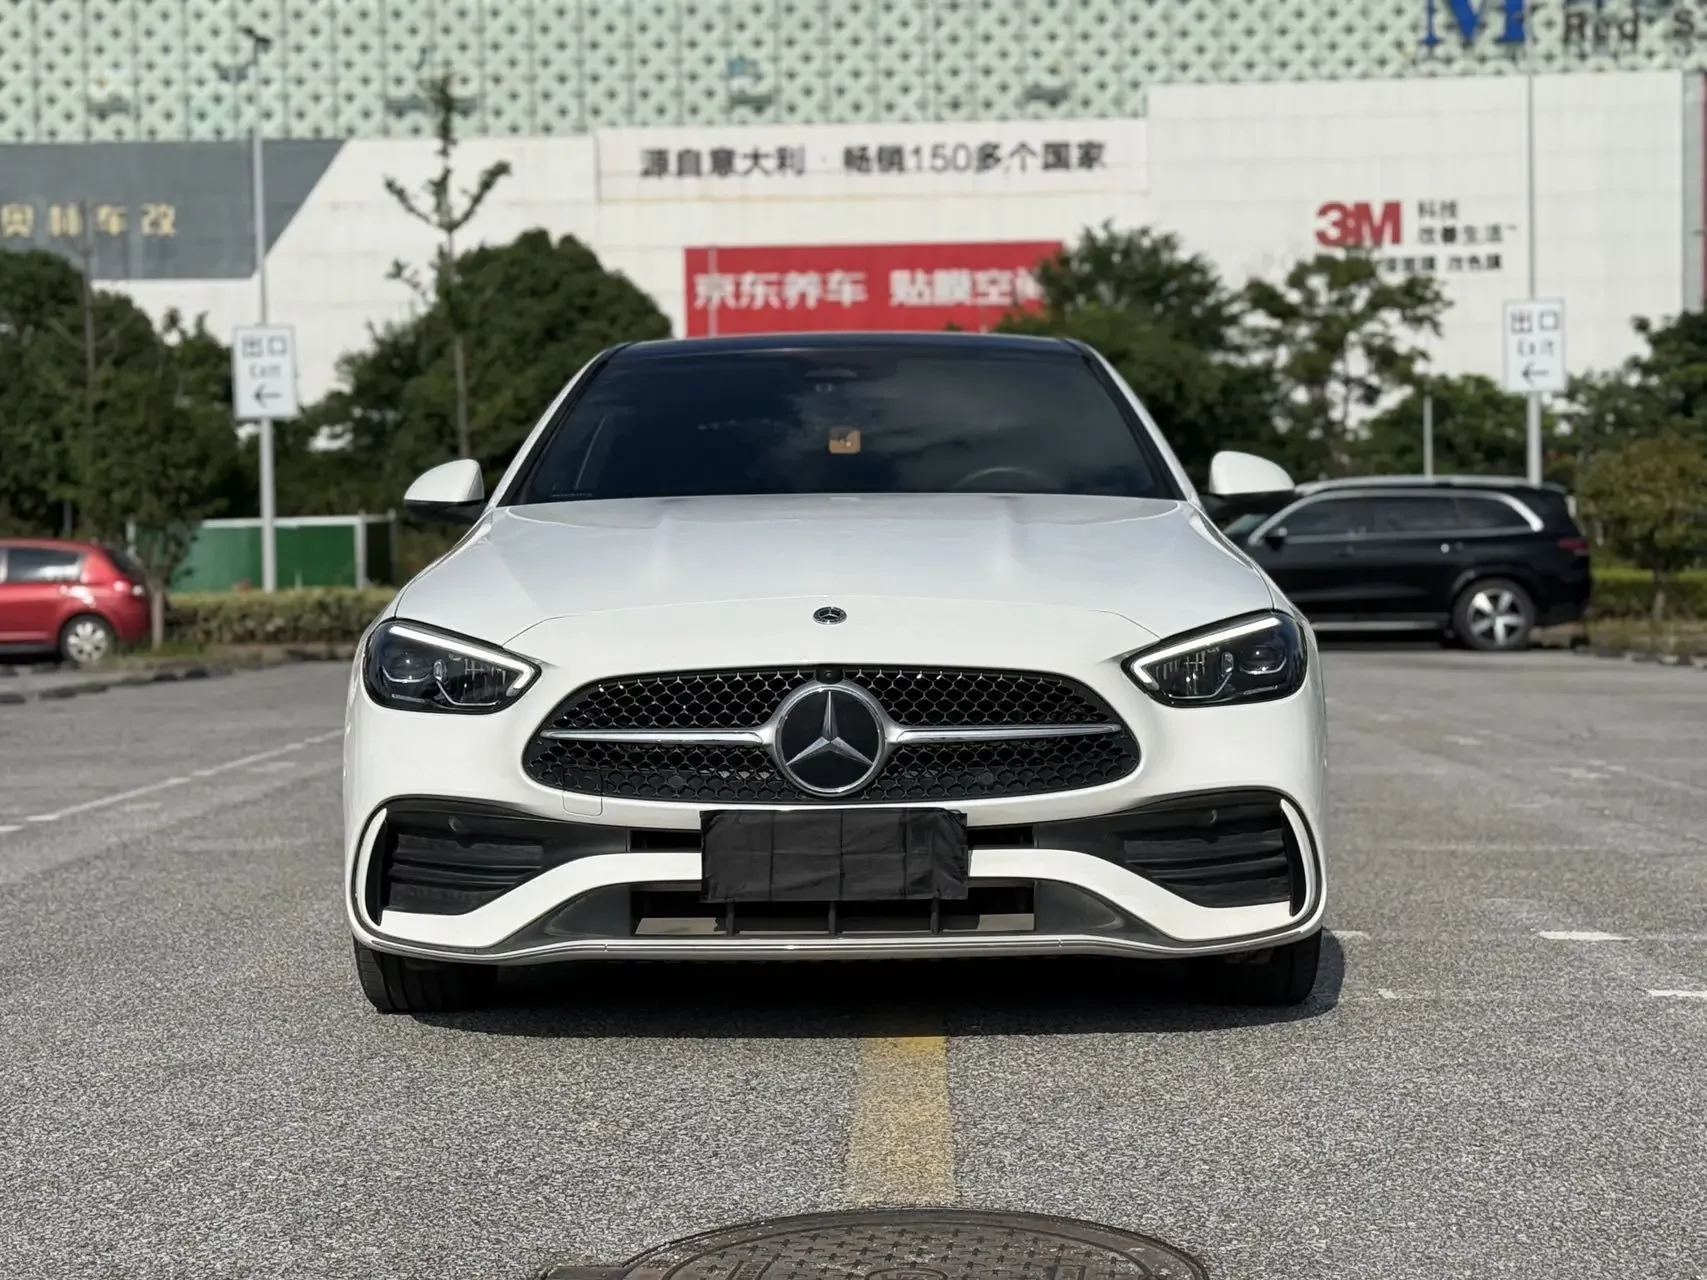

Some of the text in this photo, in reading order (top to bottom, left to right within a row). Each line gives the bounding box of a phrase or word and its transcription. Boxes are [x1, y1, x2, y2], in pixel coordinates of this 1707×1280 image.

[640, 146, 806, 178] 源自意大利
[1316, 200, 1402, 248] 3M
[694, 271, 867, 310] 京东养车
[1510, 309, 1559, 334] 出口
[241, 334, 288, 359] 出口
